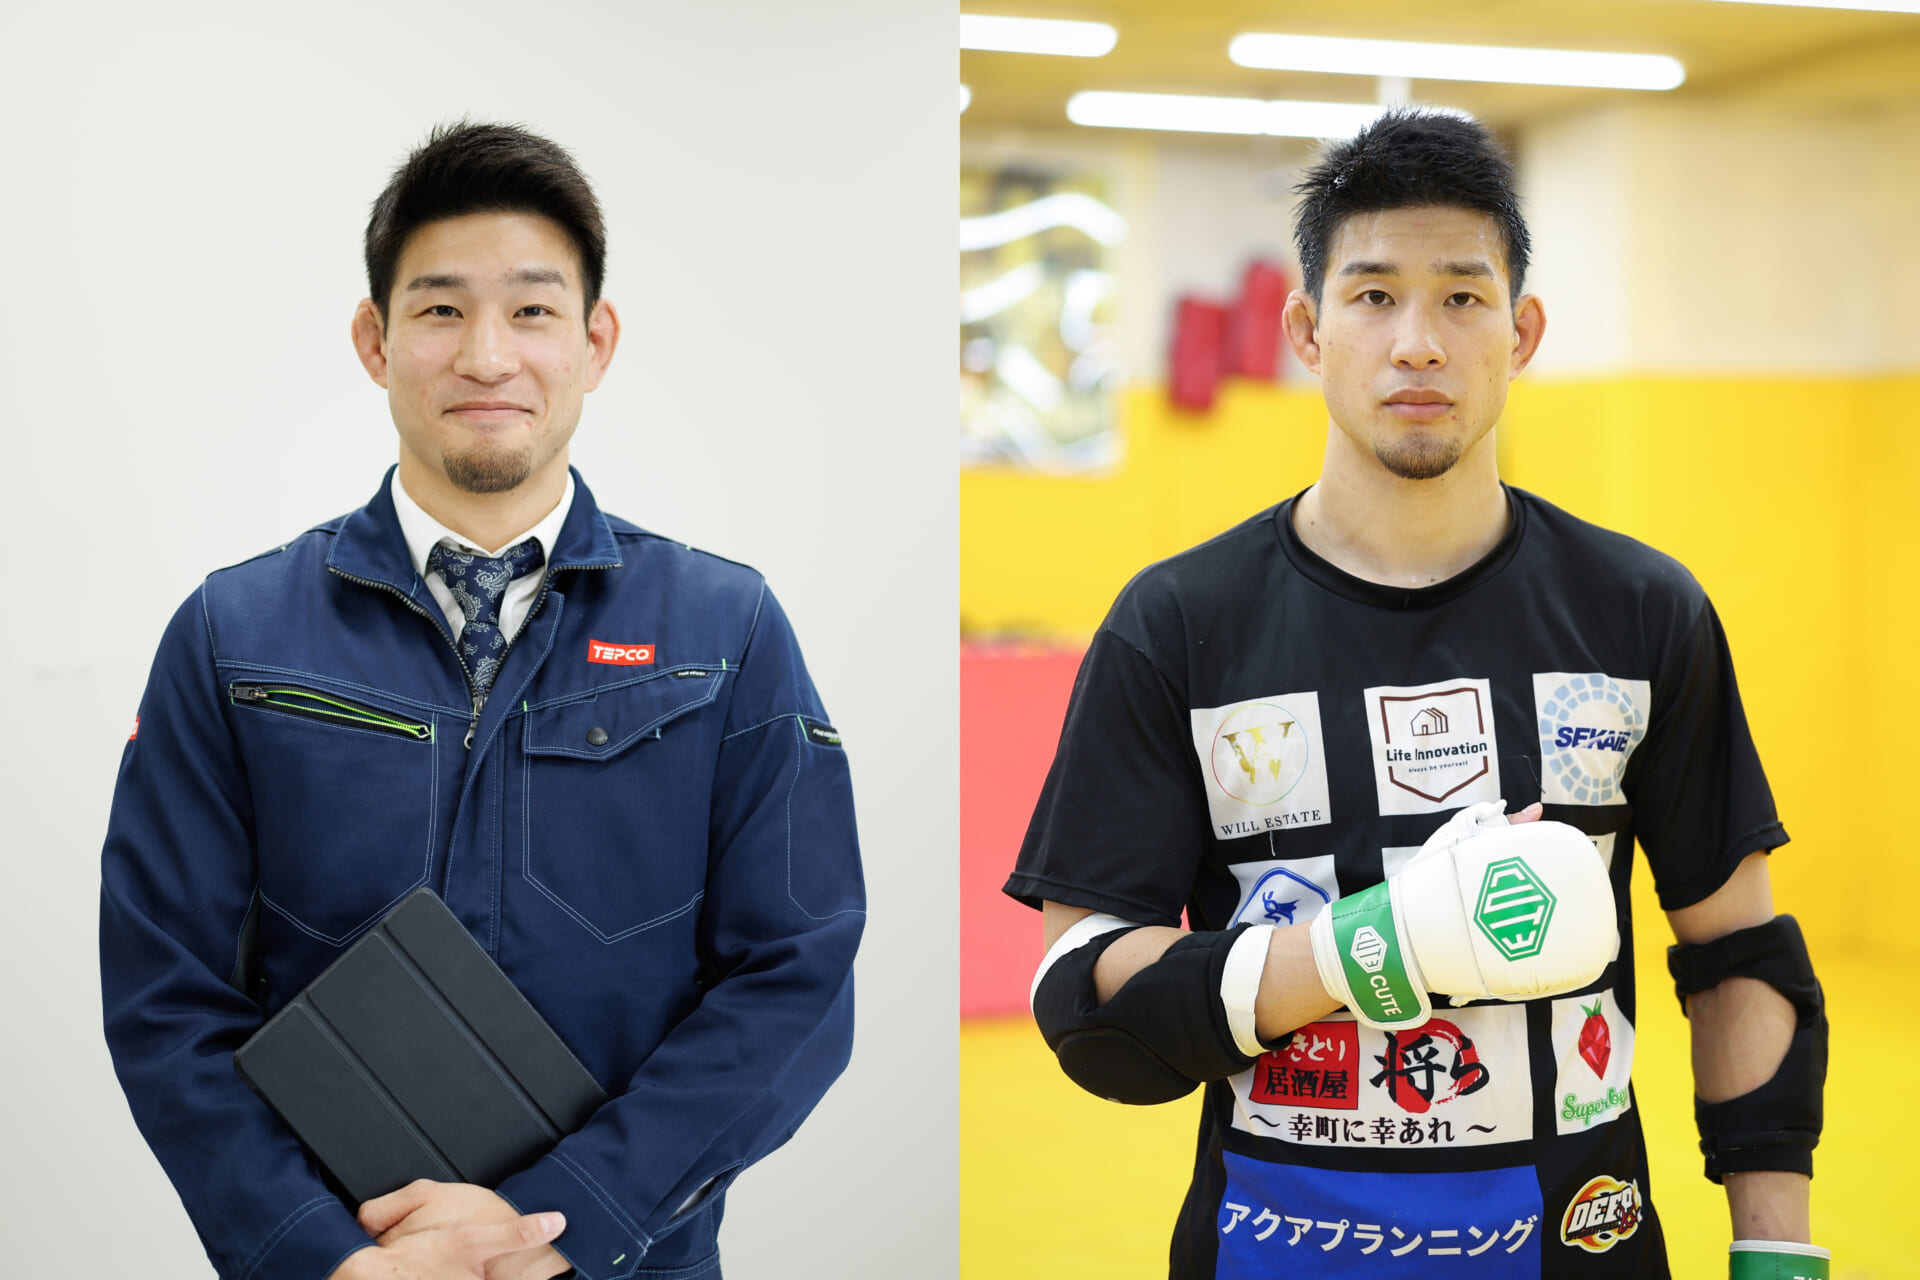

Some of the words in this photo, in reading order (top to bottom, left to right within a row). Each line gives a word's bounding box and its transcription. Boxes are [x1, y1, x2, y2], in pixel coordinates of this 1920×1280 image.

[593, 645, 649, 661] TEPCO
[1386, 749, 1412, 762] Life
[1415, 742, 1488, 760] Innovation
[1221, 820, 1260, 836] WILL
[1264, 809, 1322, 829] ESTATE
[1370, 974, 1403, 1017] CUTE
[1272, 1032, 1346, 1063] きとり
[1264, 1065, 1349, 1100] 居酒屋
[1369, 1030, 1490, 1103] 将ら
[1222, 1201, 1538, 1257] アクアプランニング
